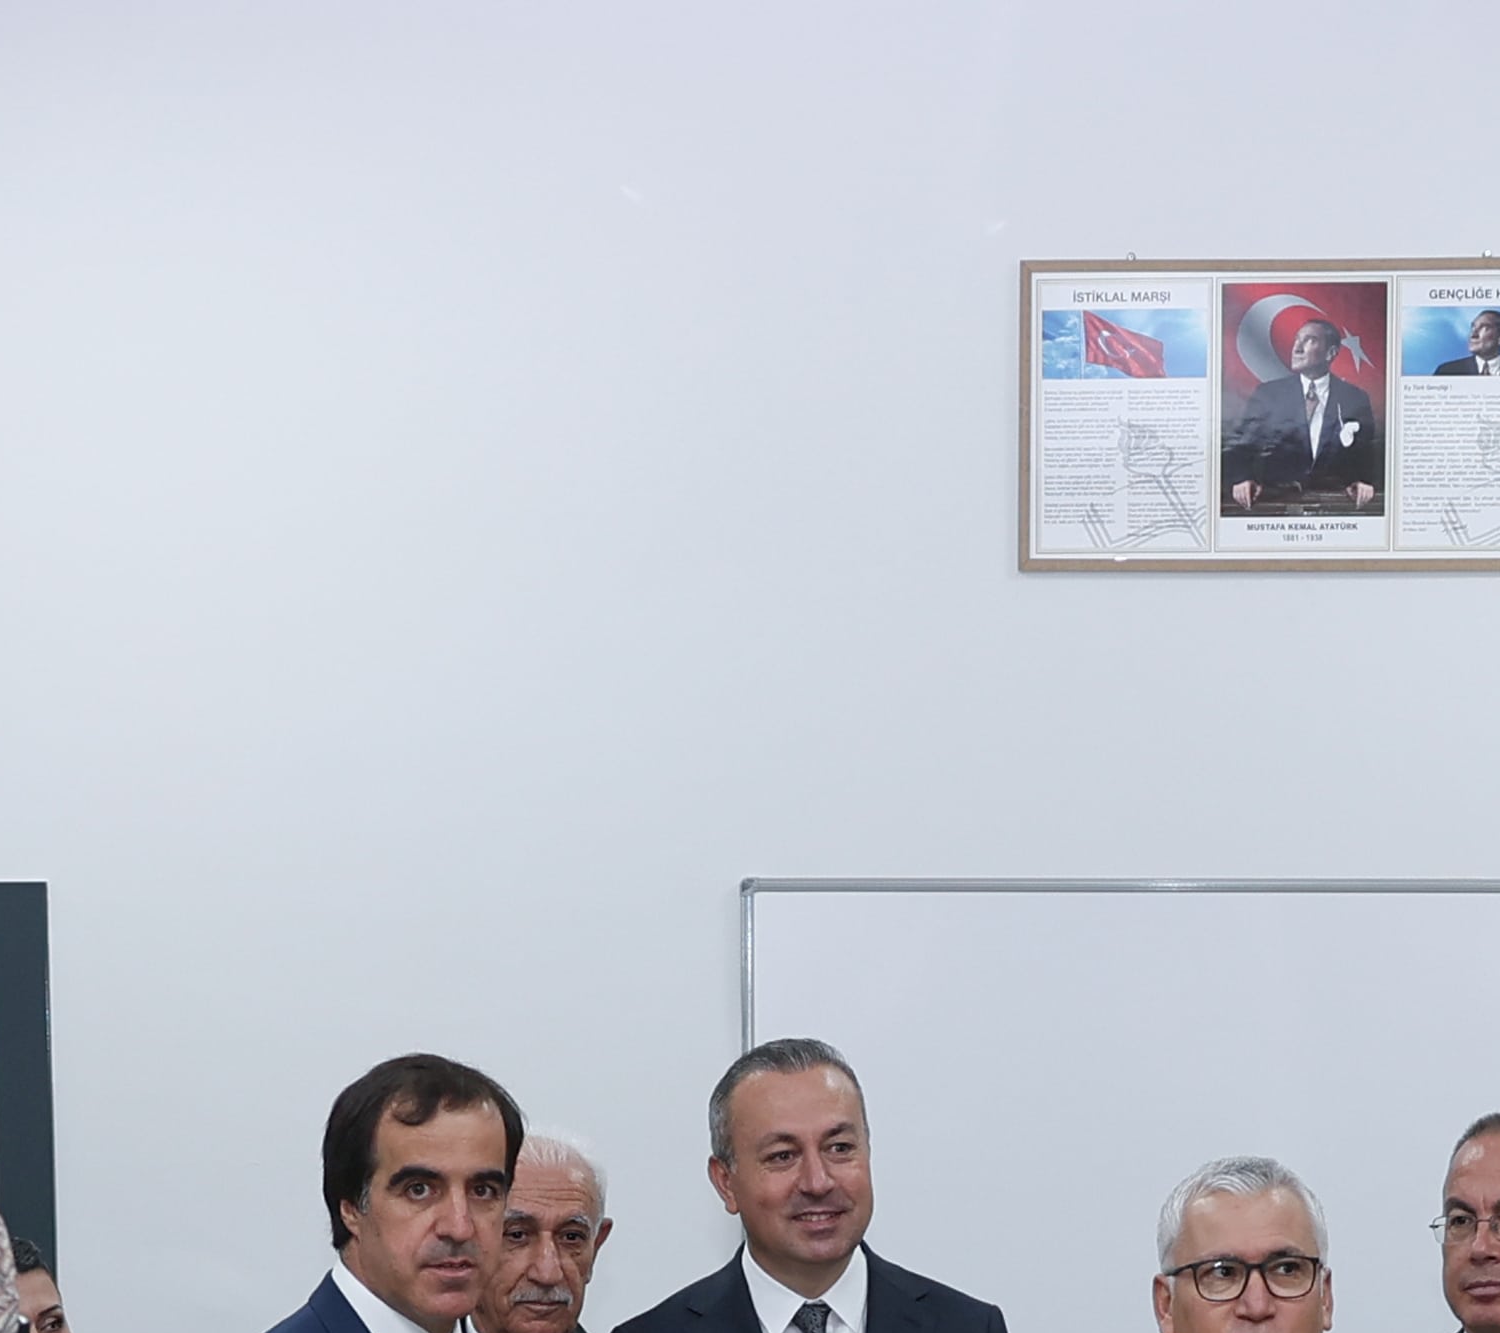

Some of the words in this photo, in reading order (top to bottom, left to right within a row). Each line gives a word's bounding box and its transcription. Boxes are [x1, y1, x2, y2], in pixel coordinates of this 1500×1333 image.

[1073, 290, 1128, 303] İSTİKLAL
[1131, 291, 1171, 304] MARŞI
[1429, 287, 1492, 301] GENÇLİĞE
[1246, 522, 1286, 531] MUSTAFA
[1288, 522, 1317, 531] KEMAL
[1319, 521, 1358, 530] ATATÜRK
